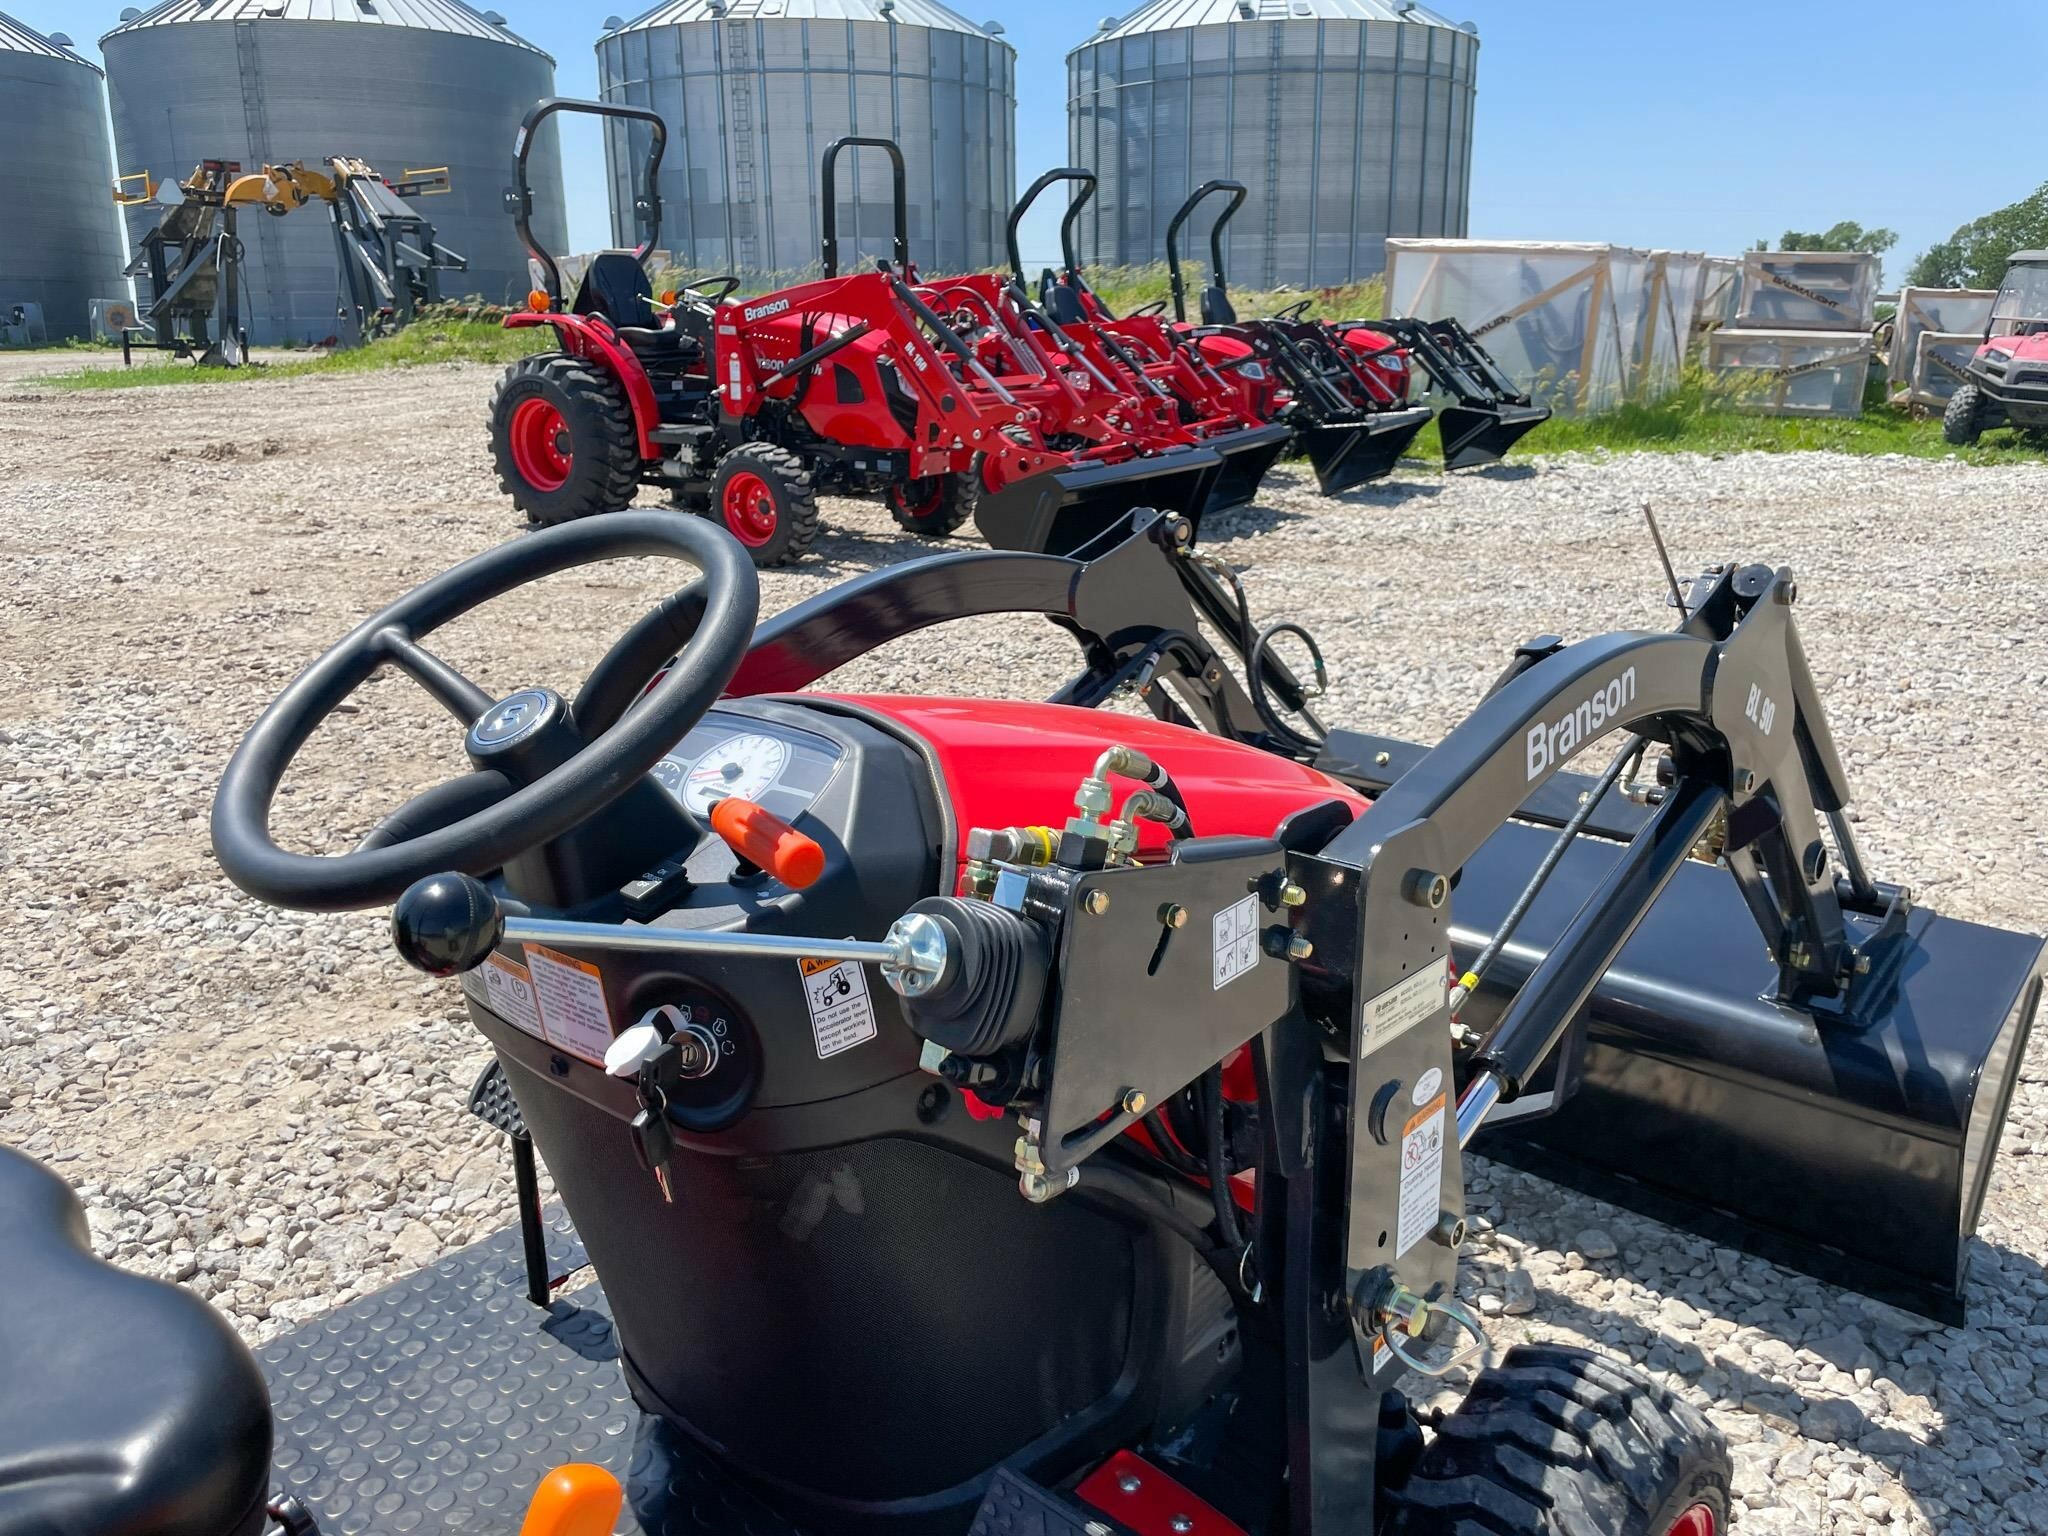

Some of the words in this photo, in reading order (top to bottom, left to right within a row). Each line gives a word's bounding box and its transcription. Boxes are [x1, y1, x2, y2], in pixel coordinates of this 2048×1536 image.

[744, 298, 790, 322] Branson
[1745, 682, 1761, 724] BL
[1759, 696, 1776, 735] 90
[1527, 666, 1636, 782] Branson
[817, 1016, 825, 1024] Do
[827, 1012, 837, 1020] not
[839, 1007, 850, 1015] use
[819, 1015, 852, 1033] accelerator
[854, 1009, 868, 1018] lever
[820, 1029, 841, 1042] except
[843, 1019, 866, 1033] working
[832, 1038, 842, 1046] the
